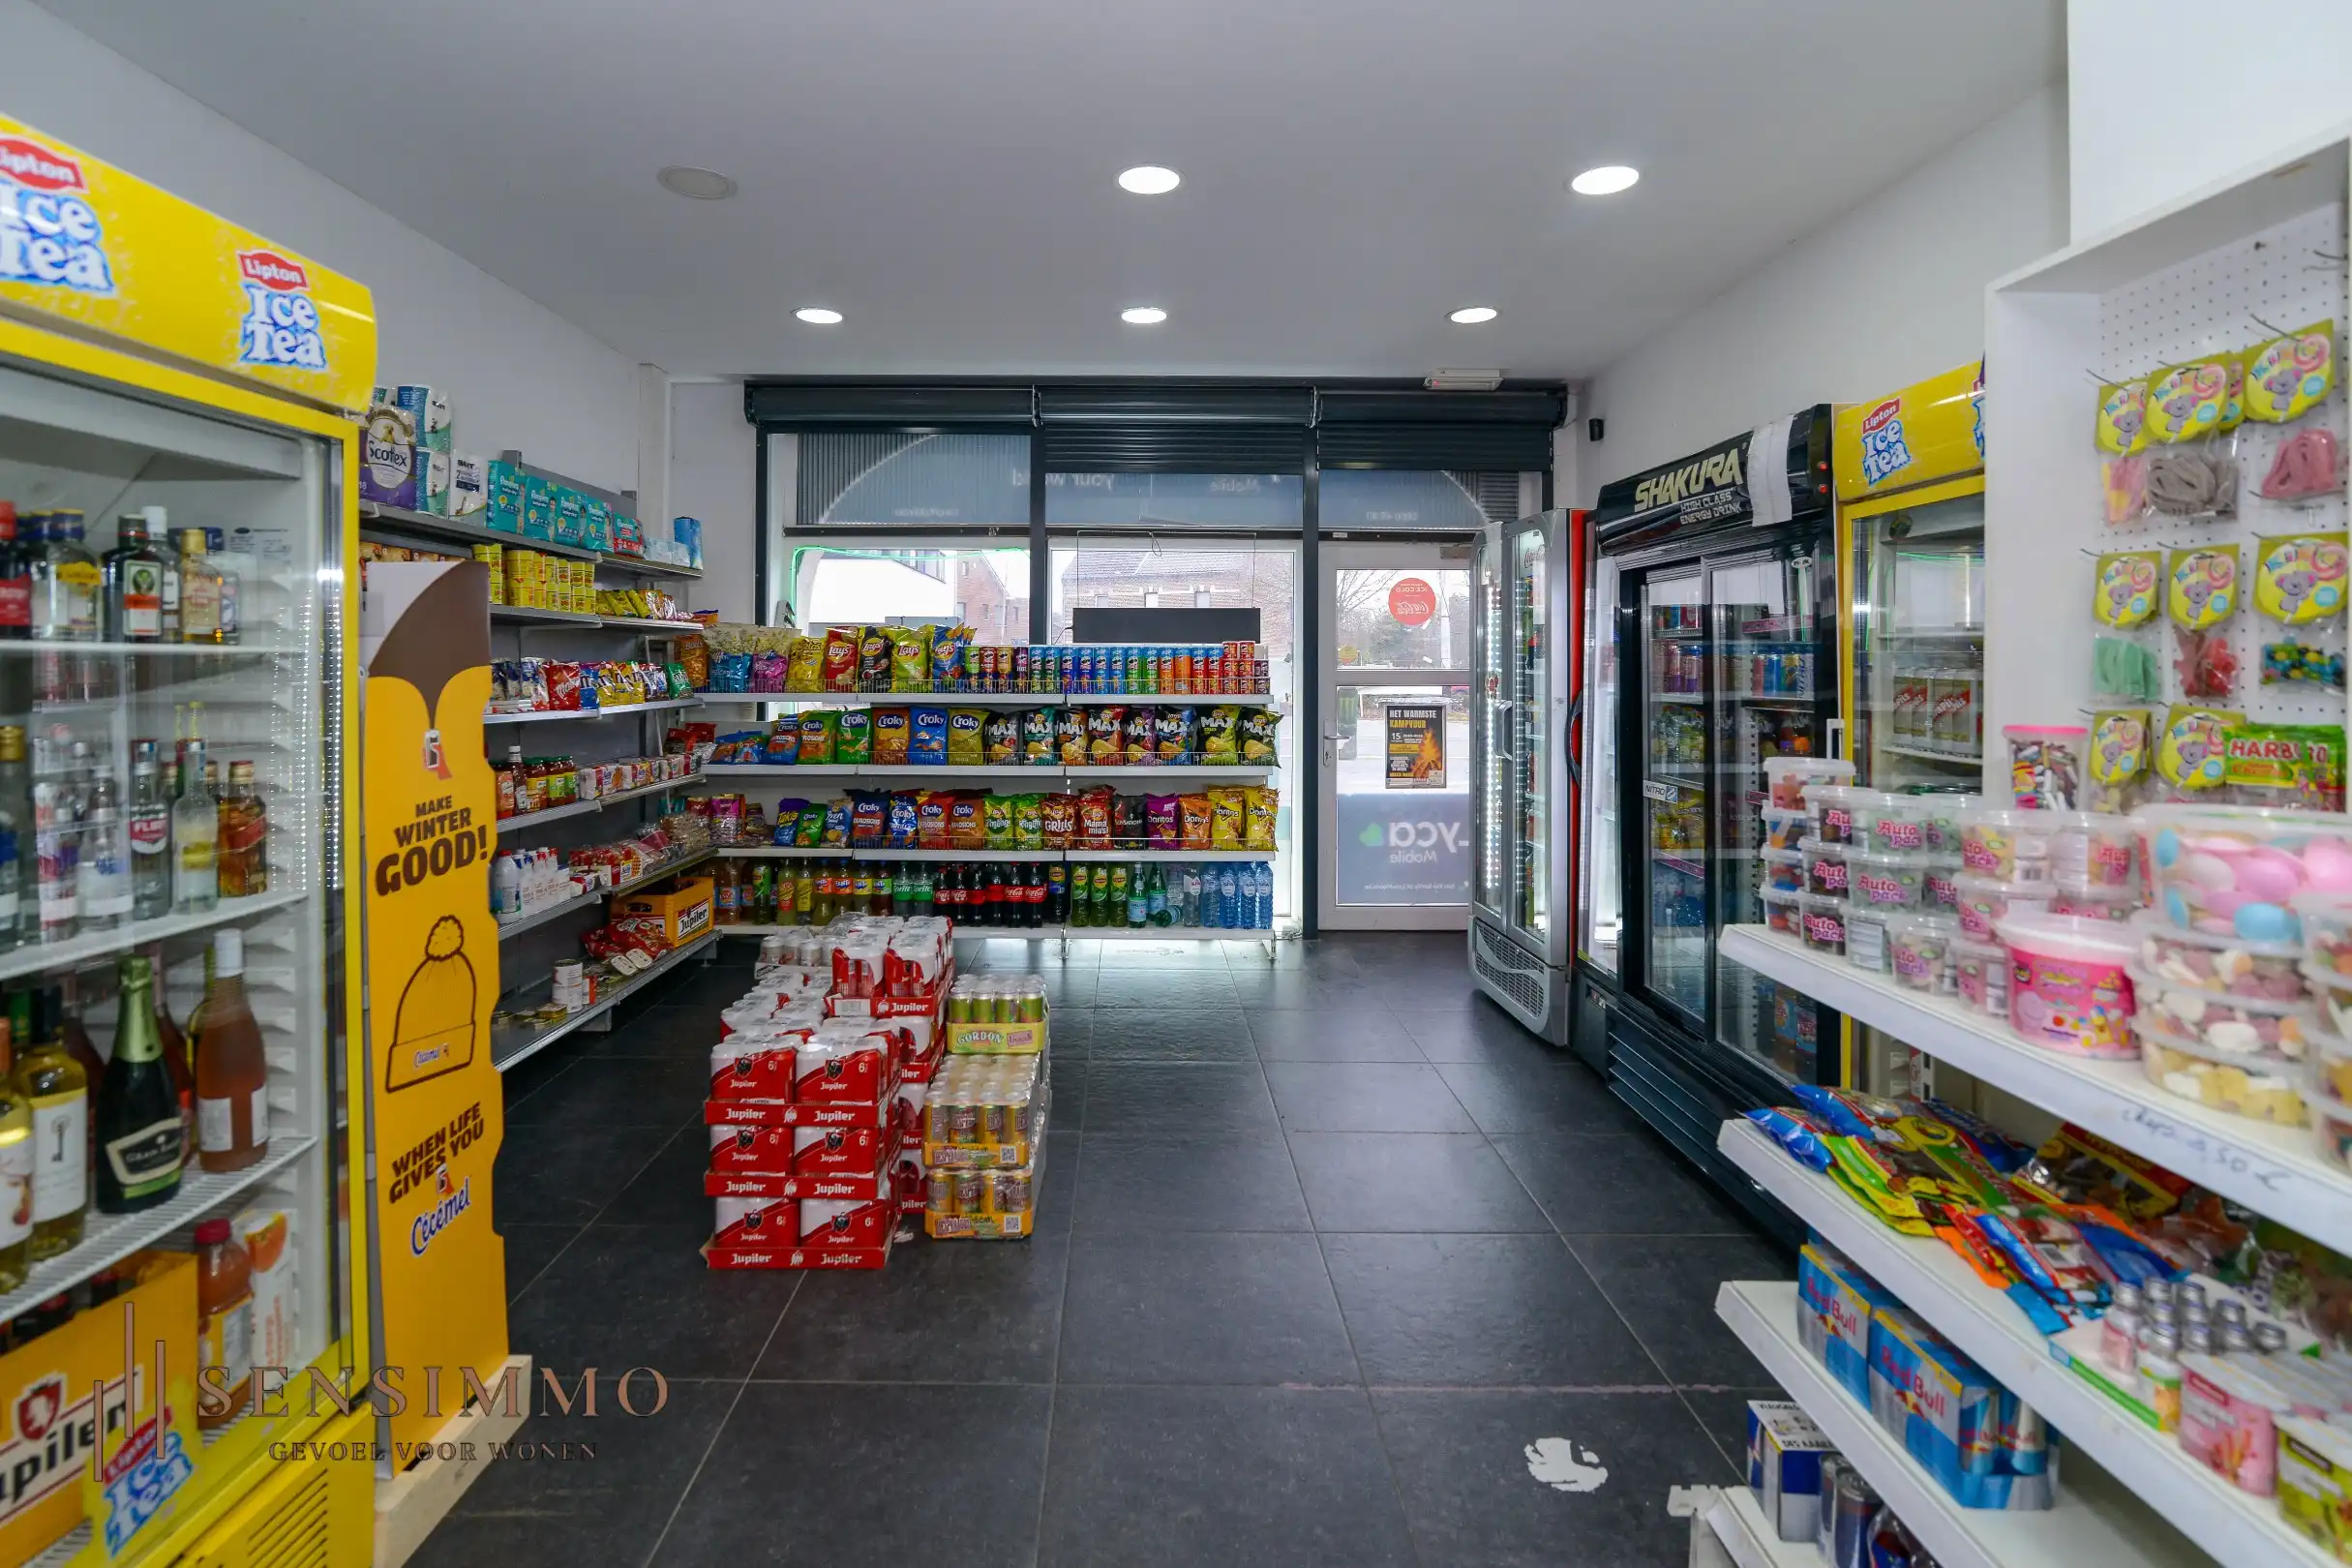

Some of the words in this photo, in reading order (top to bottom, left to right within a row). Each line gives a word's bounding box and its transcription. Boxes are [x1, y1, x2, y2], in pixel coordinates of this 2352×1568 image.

[0, 145, 76, 184] ipton
[245, 259, 304, 286] Lipton
[247, 286, 317, 329] Ice
[243, 323, 326, 367] Tea
[1864, 402, 1898, 432] Lipton
[1863, 420, 1903, 457] Ice
[368, 440, 407, 467] Scottex
[1863, 443, 1913, 485] Tea
[1634, 448, 1744, 513] SHAKURA
[1680, 498, 1702, 513] HIGH
[1704, 491, 1733, 509] CLASS
[1680, 506, 1712, 526] ENERGY
[1713, 500, 1742, 520] DRINK
[841, 714, 868, 727] Croky
[878, 715, 904, 727] Croky
[919, 713, 945, 726] Croky
[952, 715, 979, 729] Croky
[1089, 718, 1121, 731] MAX
[1156, 719, 1190, 733] MAX
[1201, 716, 1234, 728] MAX
[1024, 722, 1053, 734] MAX
[1244, 720, 1275, 736] MAX
[1645, 784, 1665, 797] NITRO
[415, 795, 452, 818] MAKE
[858, 802, 880, 813] Croky
[891, 808, 912, 818] Croky
[921, 805, 943, 815] Croky
[953, 805, 974, 815] Croky
[1213, 808, 1239, 817] Doritos
[777, 811, 799, 825] Takis
[394, 807, 471, 848] WINTER
[1044, 820, 1073, 832] GRILLS
[1876, 819, 1917, 835] Auto
[376, 825, 488, 896] GOOD!
[1858, 874, 1898, 890] Auto
[679, 906, 708, 933] Jupiler
[890, 1002, 929, 1013] Jupiler
[955, 1032, 1003, 1046] GORDON
[859, 1063, 864, 1072] 6
[730, 1079, 757, 1088] Jupiler
[820, 1081, 847, 1091] Jupiler
[726, 1108, 766, 1120] Jupiler
[814, 1110, 855, 1122] Jupiler
[392, 1127, 446, 1178] WHEN
[449, 1101, 481, 1139] LIFE
[859, 1136, 865, 1146] 6
[389, 1152, 447, 1204] GIVES
[450, 1118, 484, 1157] YOU
[732, 1152, 759, 1161] Jupiler
[820, 1154, 847, 1163] Jupiler
[726, 1181, 766, 1192] Jupiler
[814, 1183, 855, 1195] Jupiler
[410, 1176, 470, 1256] Cécémel
[865, 1217, 871, 1226] 6
[739, 1233, 767, 1242] Jupiler
[828, 1235, 855, 1244] Jupiler
[732, 1252, 772, 1265] Jupiler
[821, 1252, 861, 1265] Jupiler
[1807, 1277, 1830, 1313] Red
[1832, 1300, 1856, 1337] Bull
[1881, 1345, 1912, 1388] Red
[1913, 1373, 1945, 1418] Bull
